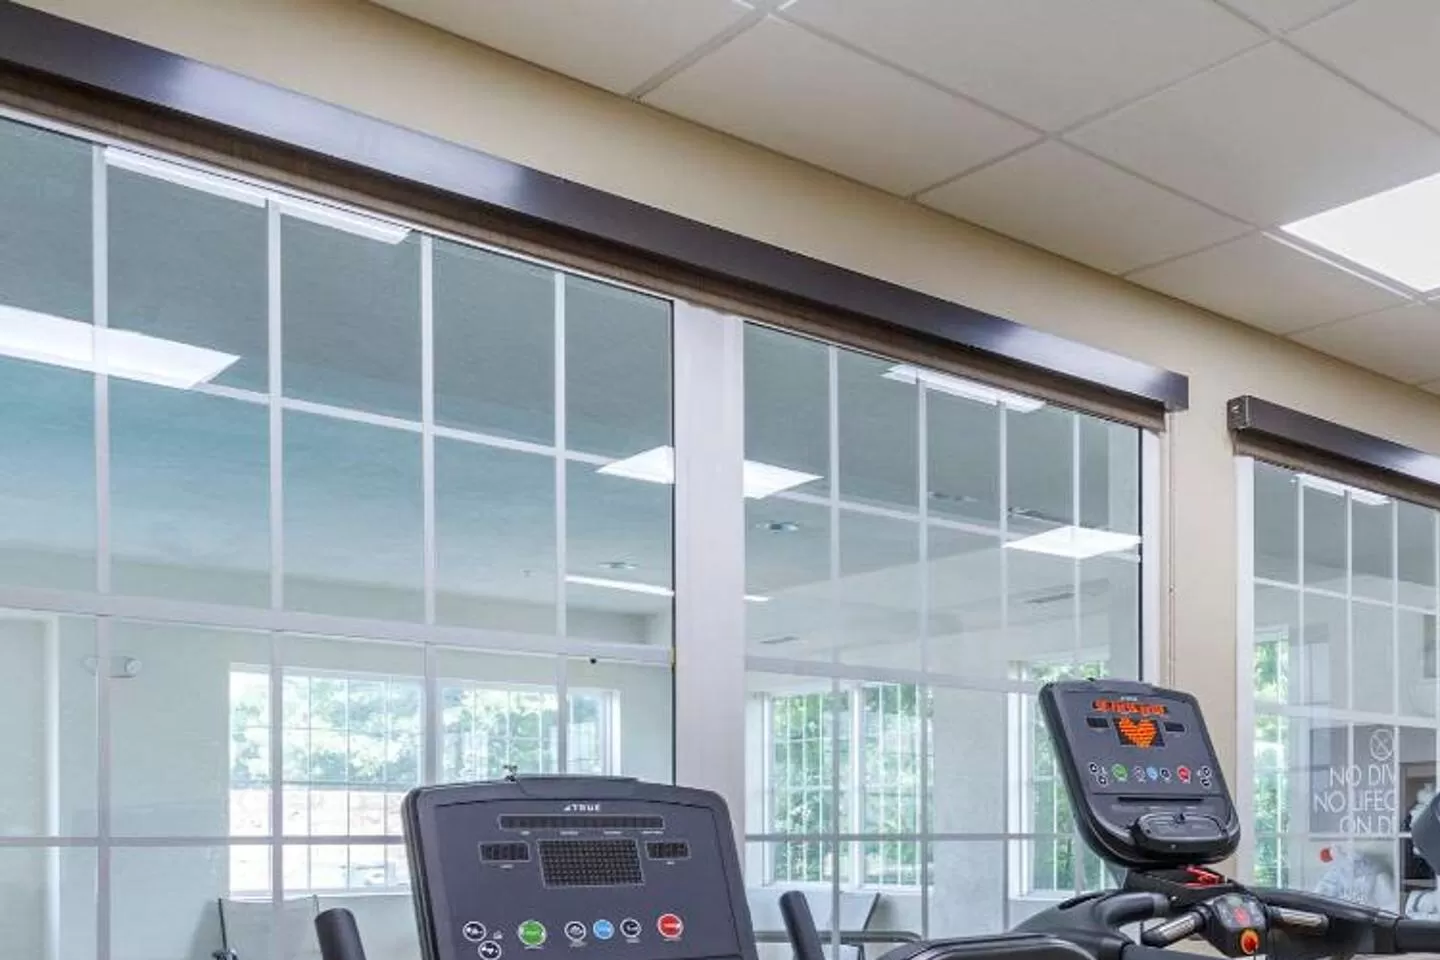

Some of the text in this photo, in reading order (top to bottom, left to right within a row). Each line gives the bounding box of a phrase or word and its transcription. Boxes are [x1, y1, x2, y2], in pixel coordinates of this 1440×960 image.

[1329, 764, 1362, 787] NO
[1313, 790, 1346, 813] NO
[1340, 815, 1372, 835] ON
